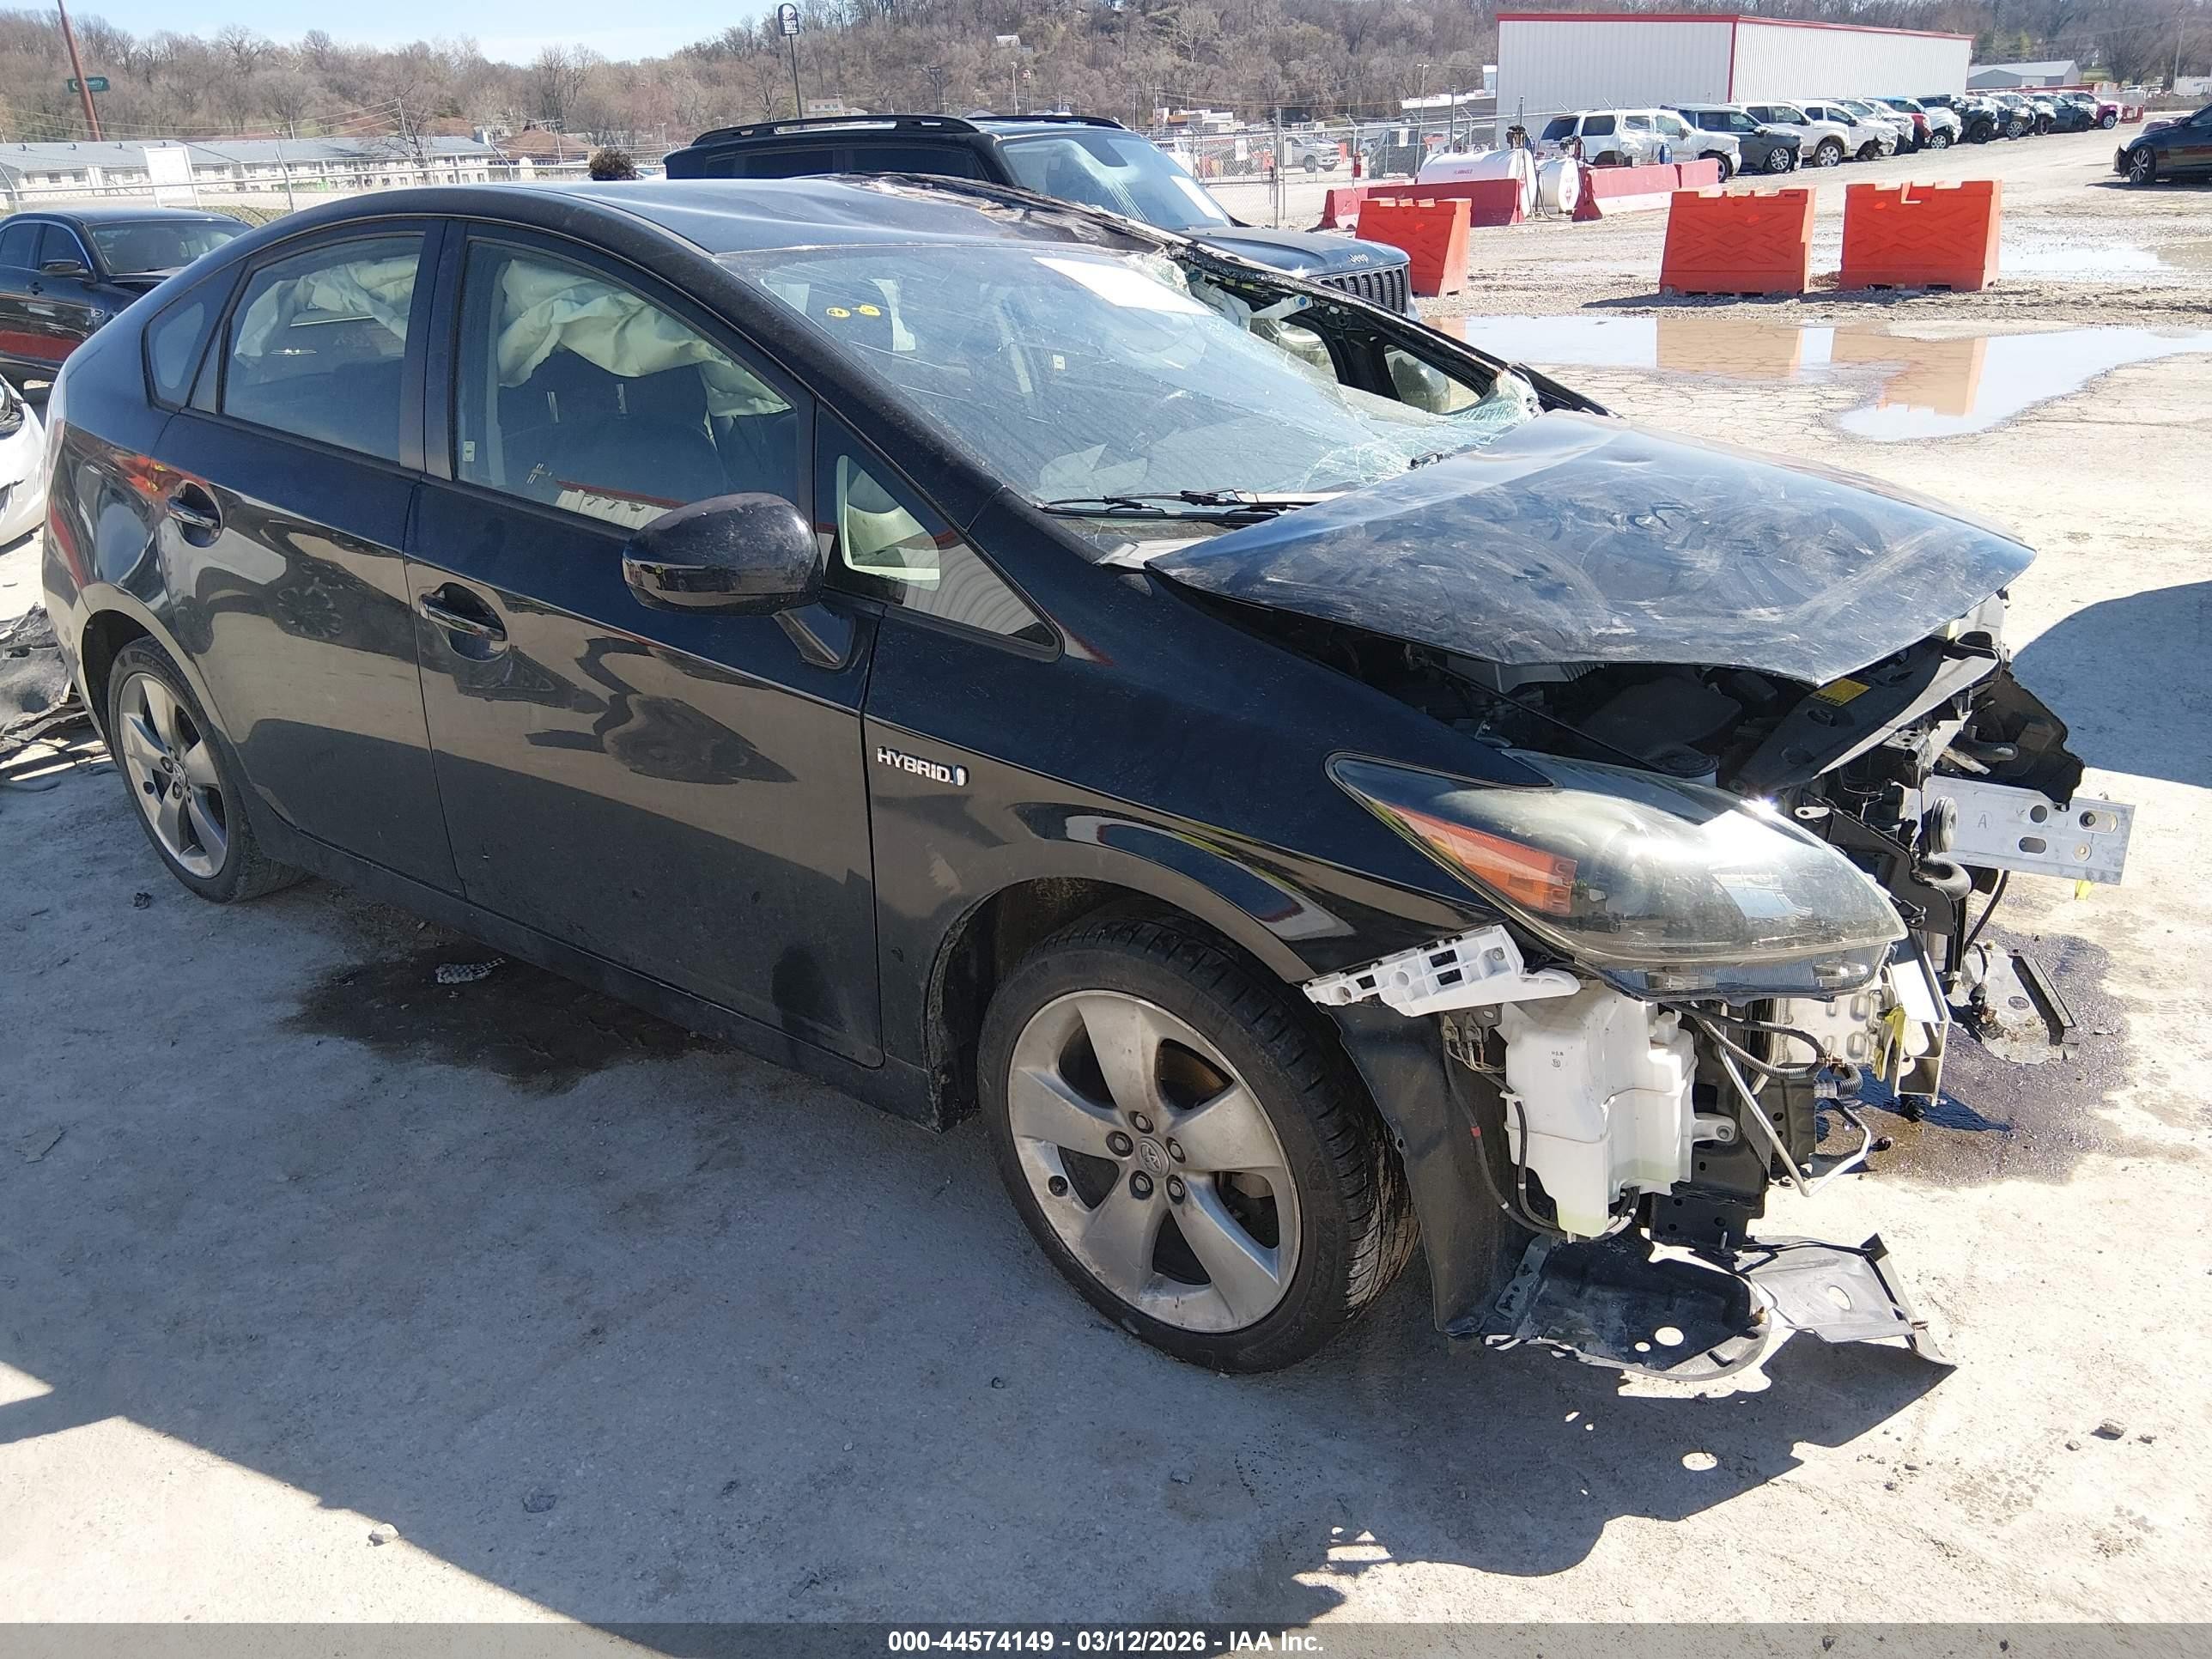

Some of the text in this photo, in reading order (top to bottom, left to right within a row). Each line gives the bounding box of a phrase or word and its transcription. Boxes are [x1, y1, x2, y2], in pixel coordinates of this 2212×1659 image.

[1348, 253, 1369, 264] Jeep
[877, 746, 951, 784] HYBRID
[1978, 813, 1987, 830] A
